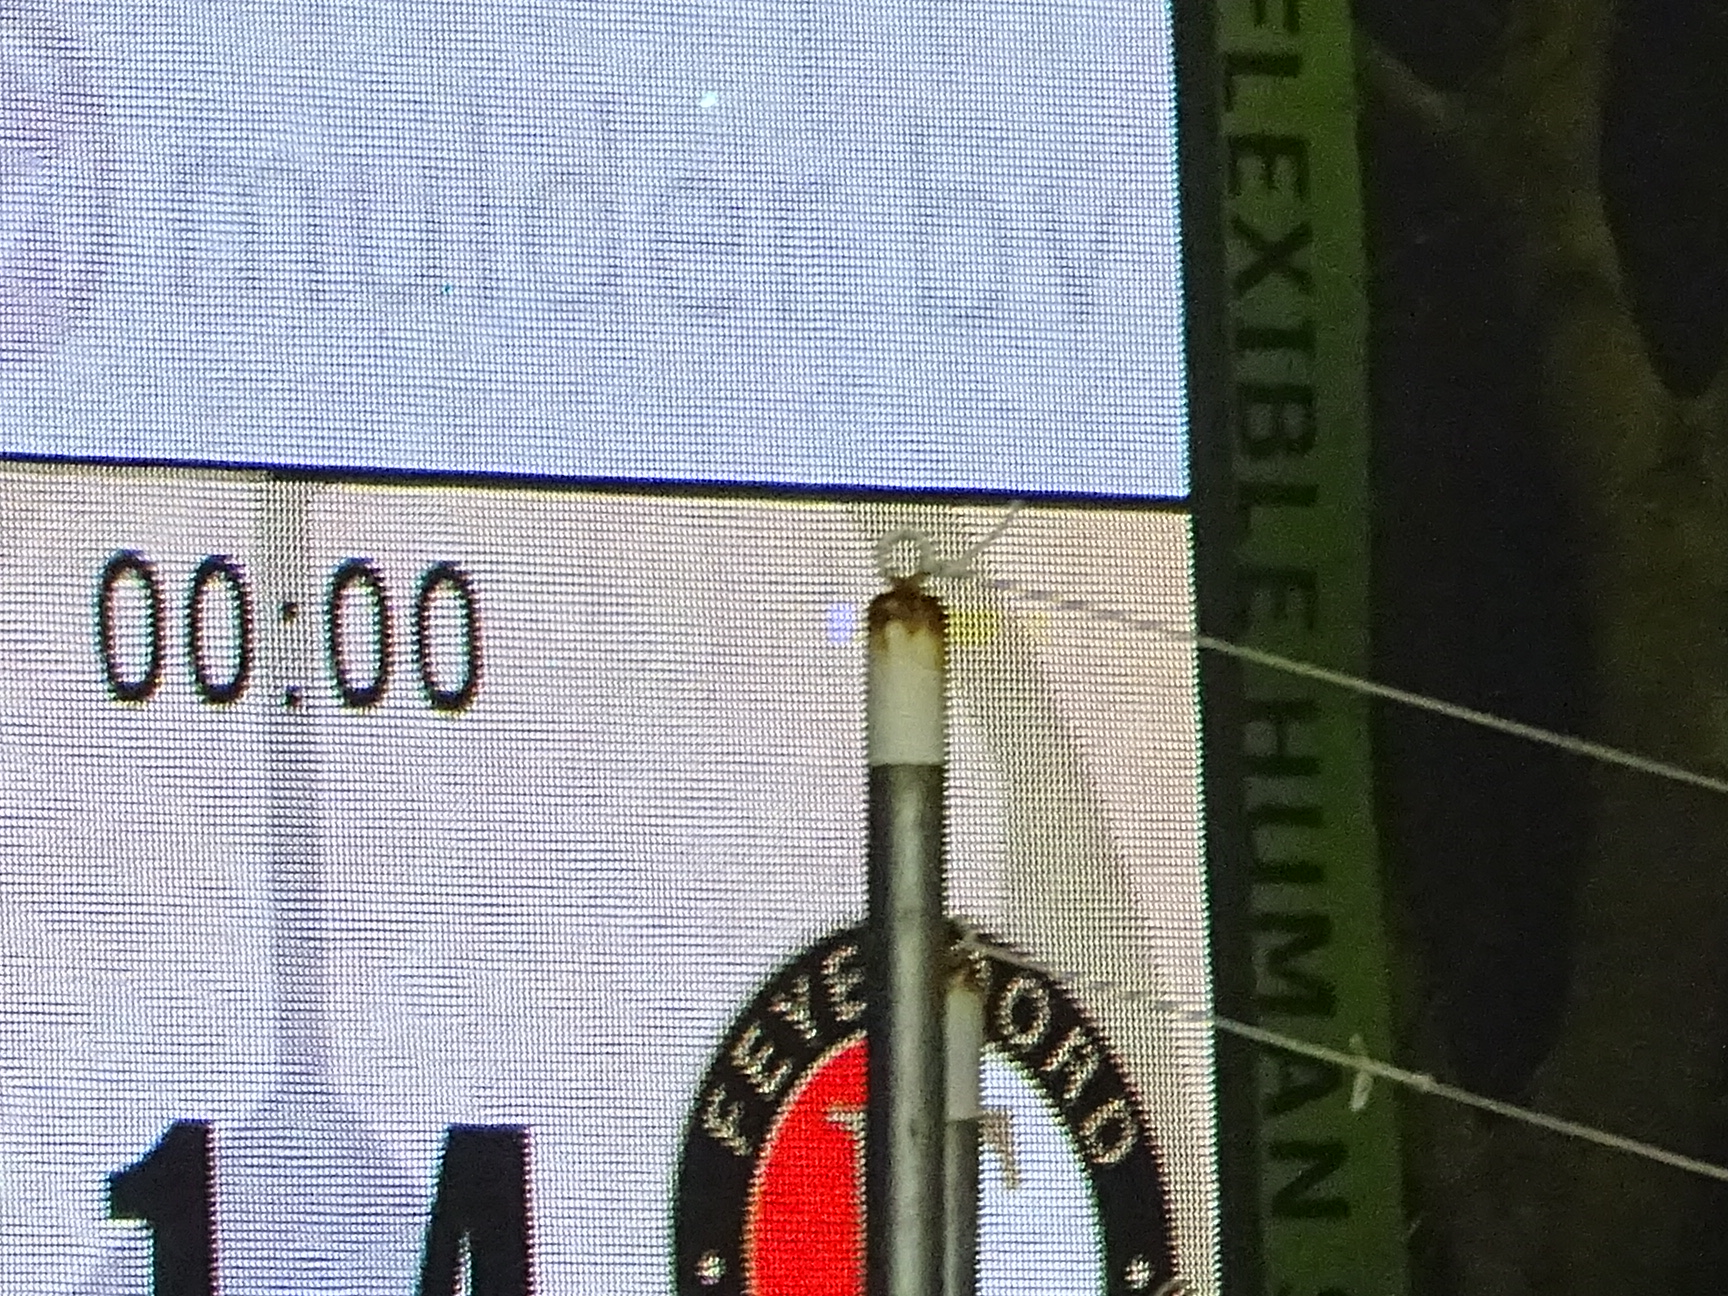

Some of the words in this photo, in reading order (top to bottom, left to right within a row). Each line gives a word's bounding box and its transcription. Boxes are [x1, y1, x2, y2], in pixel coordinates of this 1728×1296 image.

[170, 90, 836, 320] mulder
[900, 110, 1122, 329] bv
[97, 550, 478, 712] 00:00
[1244, 699, 1353, 1218] HUMAN
